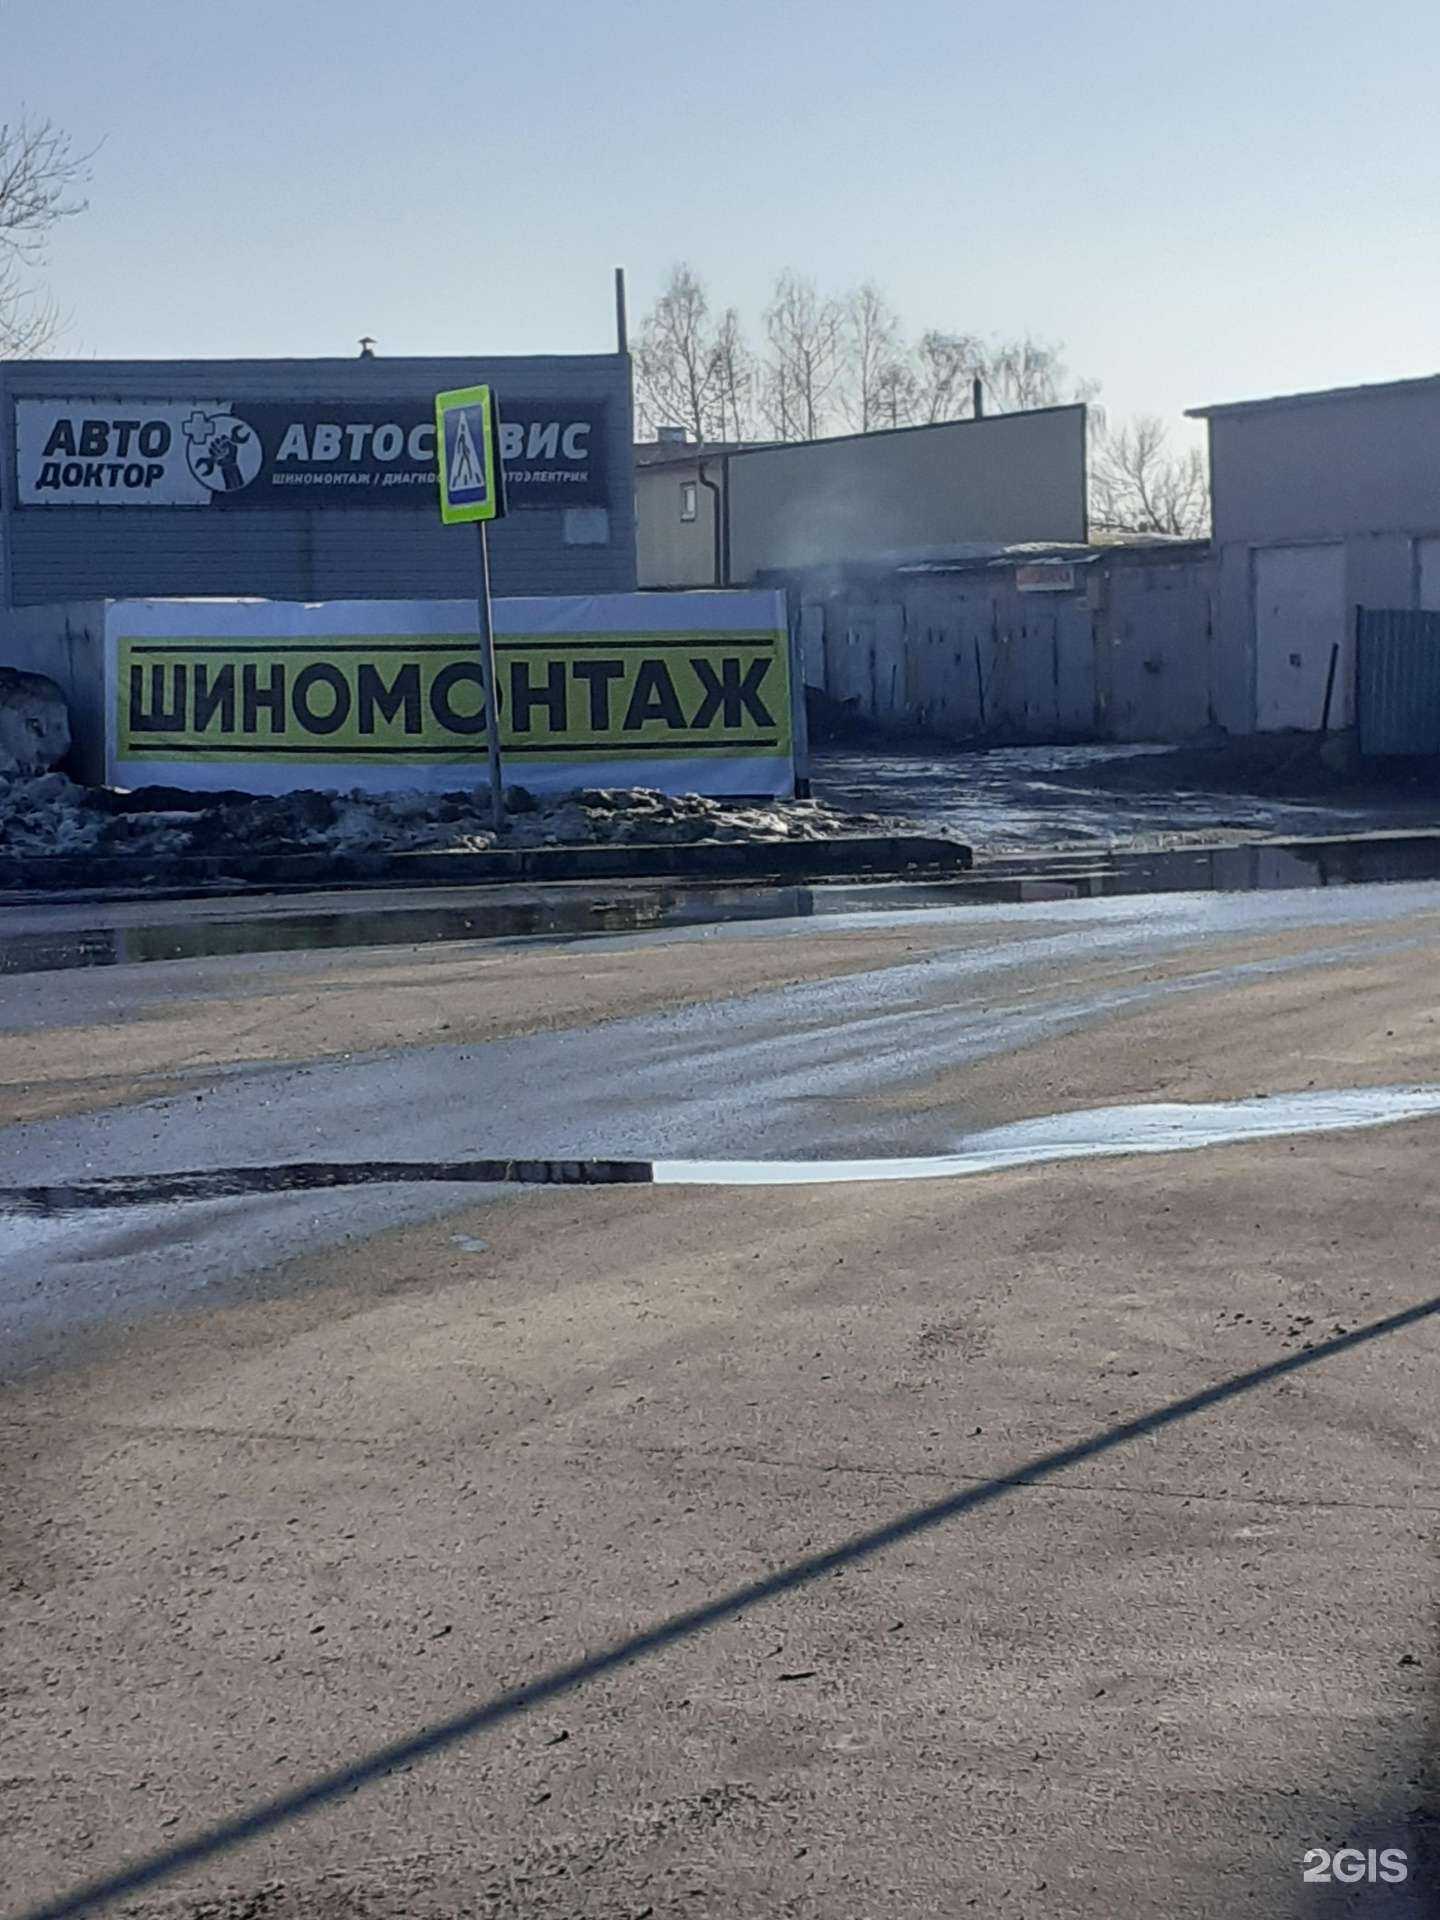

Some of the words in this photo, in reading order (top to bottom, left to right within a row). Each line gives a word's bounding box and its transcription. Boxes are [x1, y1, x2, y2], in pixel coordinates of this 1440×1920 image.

[41, 419, 172, 458] АВТО
[276, 422, 592, 461] АВТОСВИС
[35, 462, 165, 490] ДОКТОР
[272, 473, 370, 485] ШИНОМОНТАЖ
[128, 656, 776, 736] ШИНОМОНТАЖ
